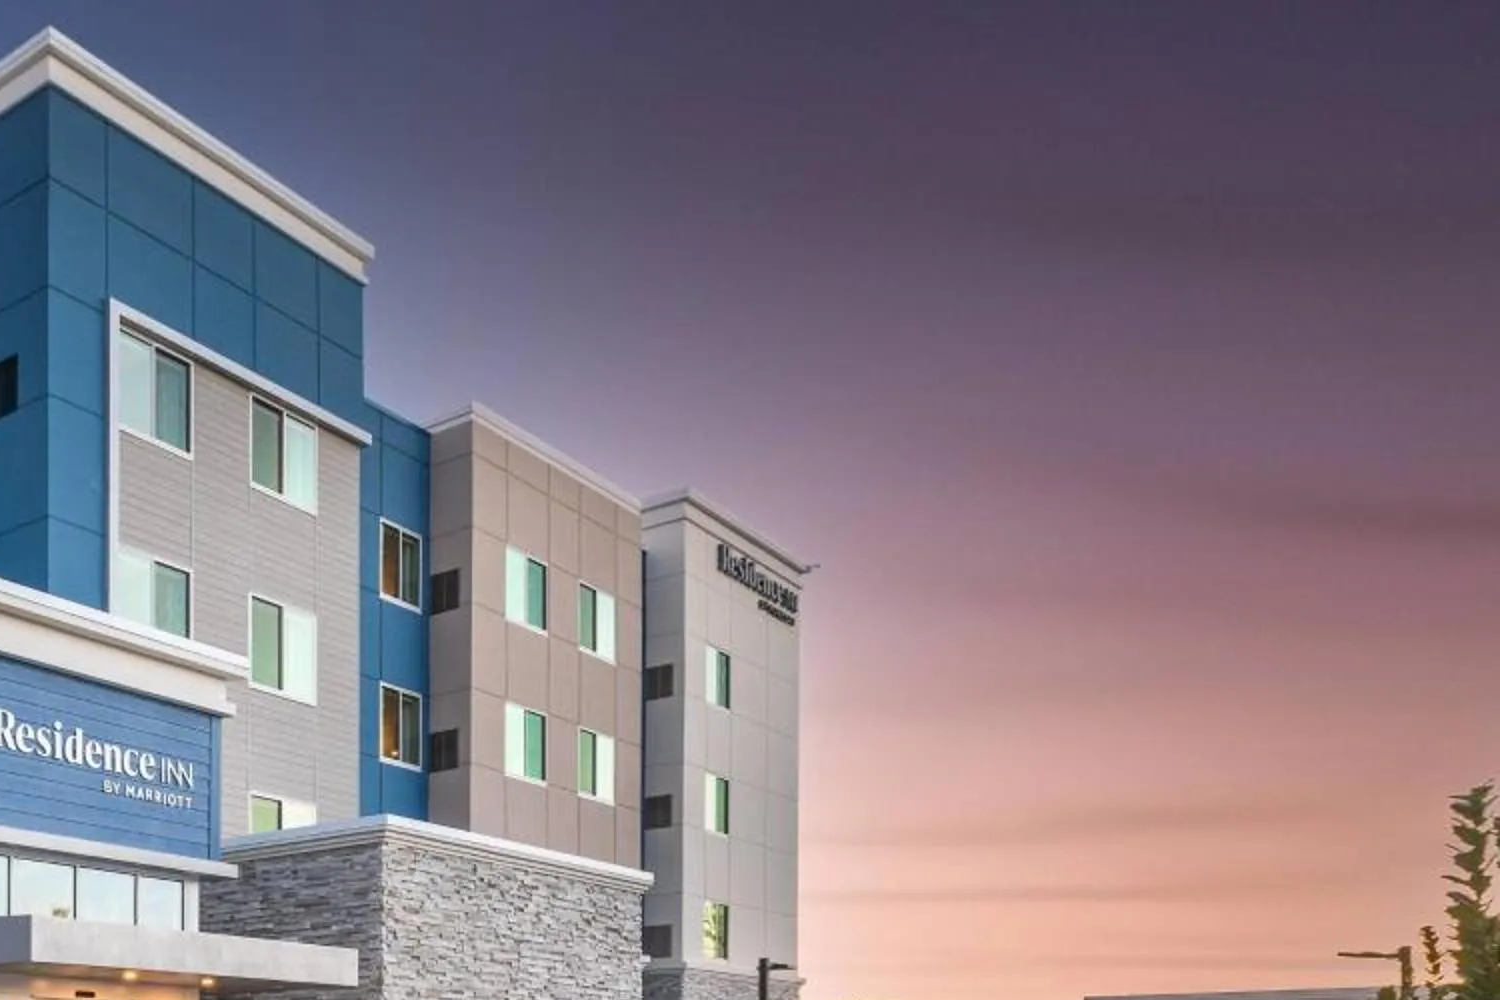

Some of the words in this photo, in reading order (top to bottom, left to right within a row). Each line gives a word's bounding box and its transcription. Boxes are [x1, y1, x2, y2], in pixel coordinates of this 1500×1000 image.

[160, 757, 194, 789] INN
[103, 779, 120, 794] BY
[125, 784, 192, 808] MARRIOTT
